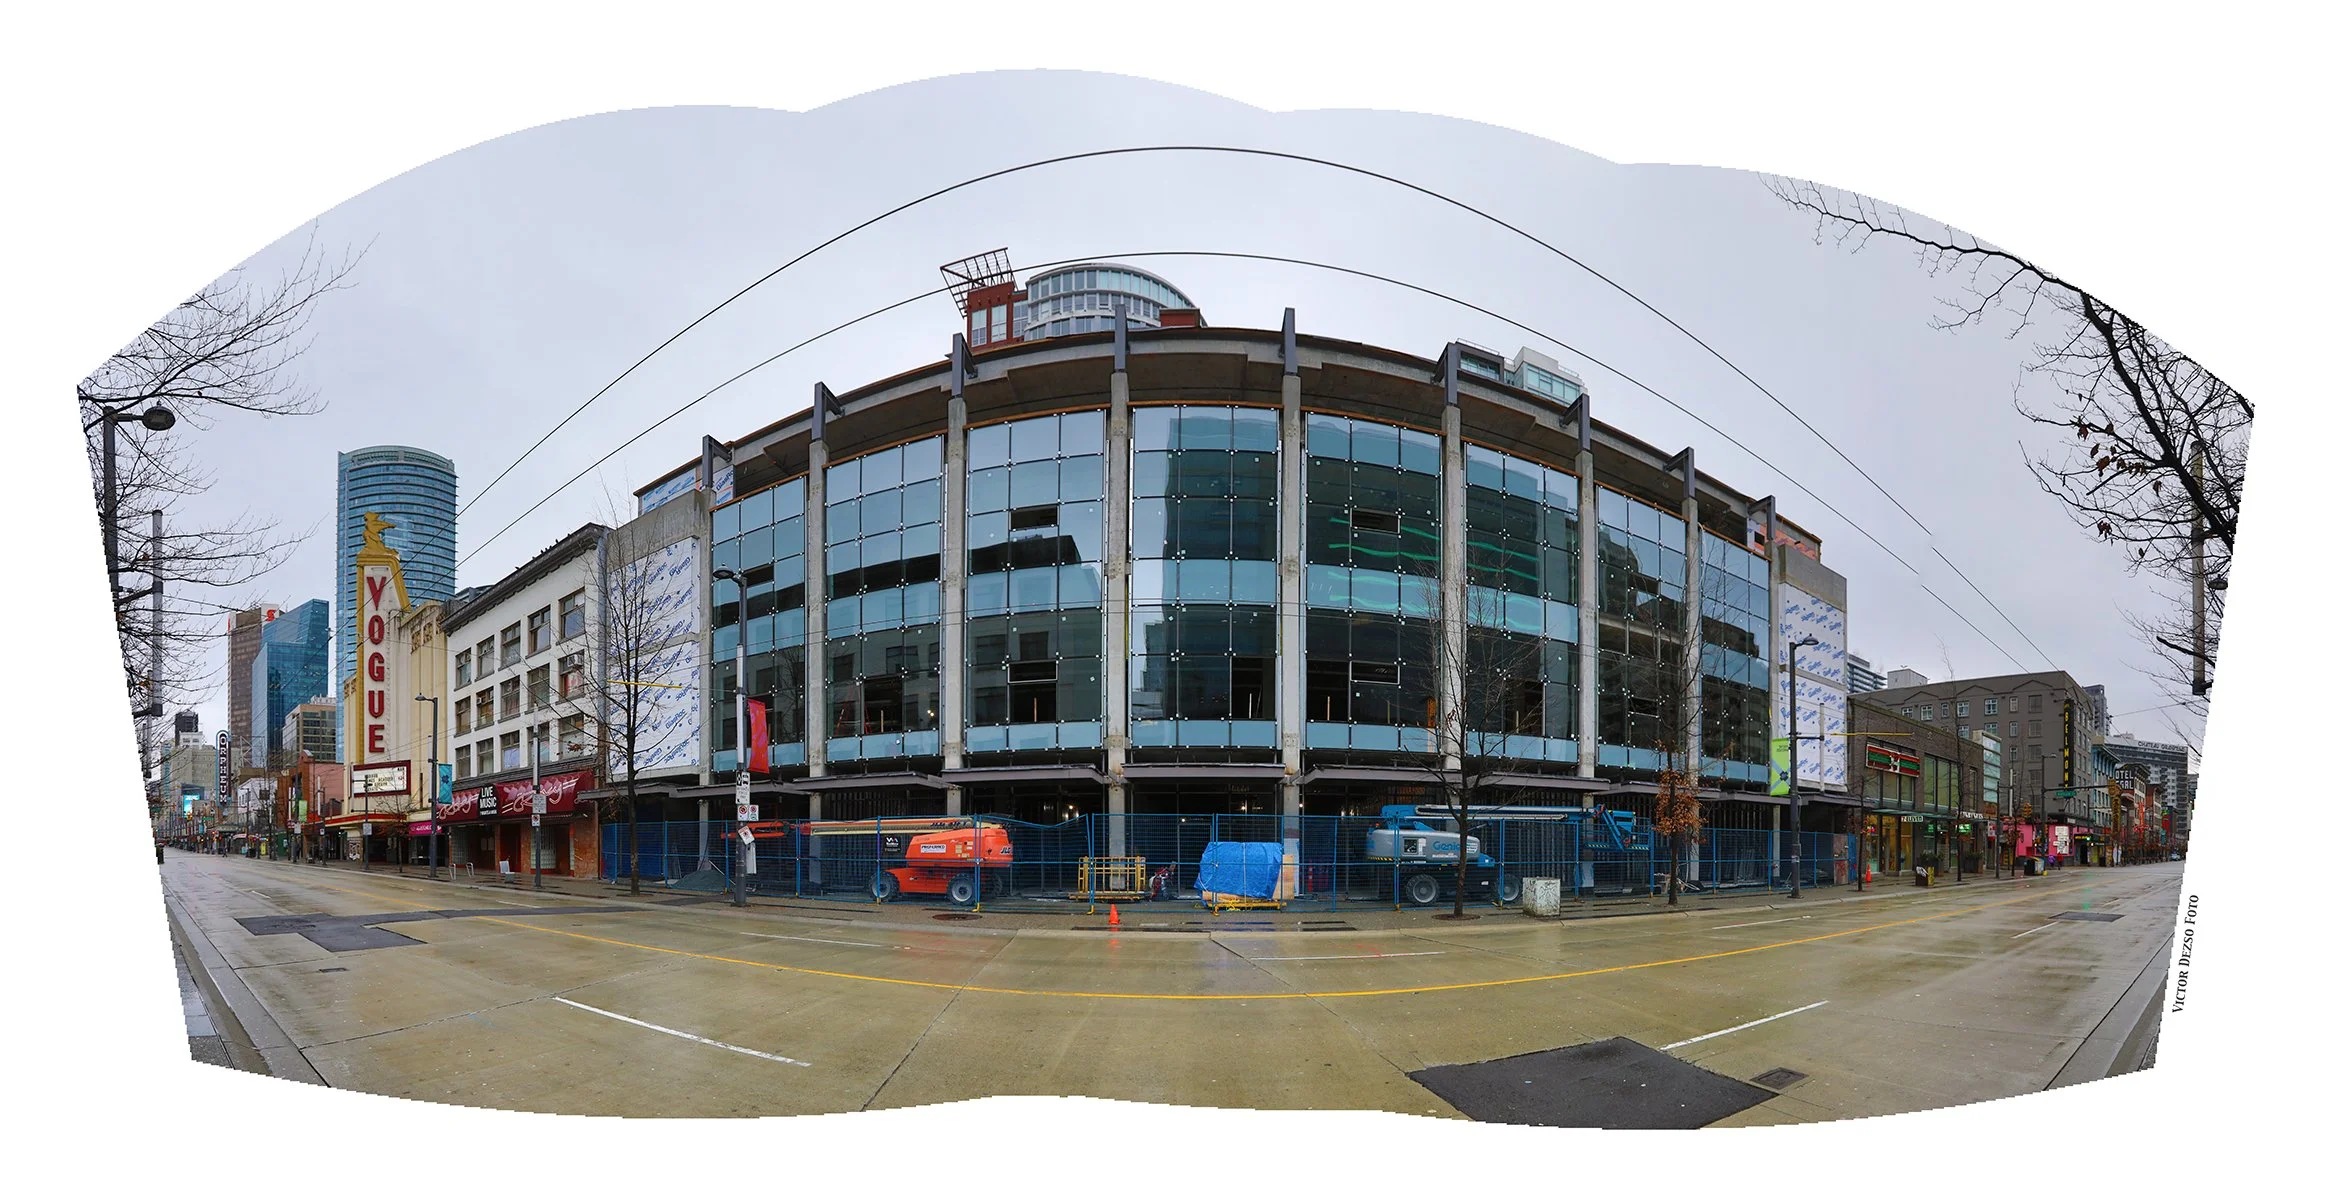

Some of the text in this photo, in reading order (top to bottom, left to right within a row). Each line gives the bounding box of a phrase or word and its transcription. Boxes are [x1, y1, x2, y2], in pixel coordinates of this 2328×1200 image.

[367, 577, 387, 752] VOGUE
[2115, 770, 2133, 779] OTEL
[481, 786, 493, 798] LIVE
[480, 797, 497, 809] MUSIC
